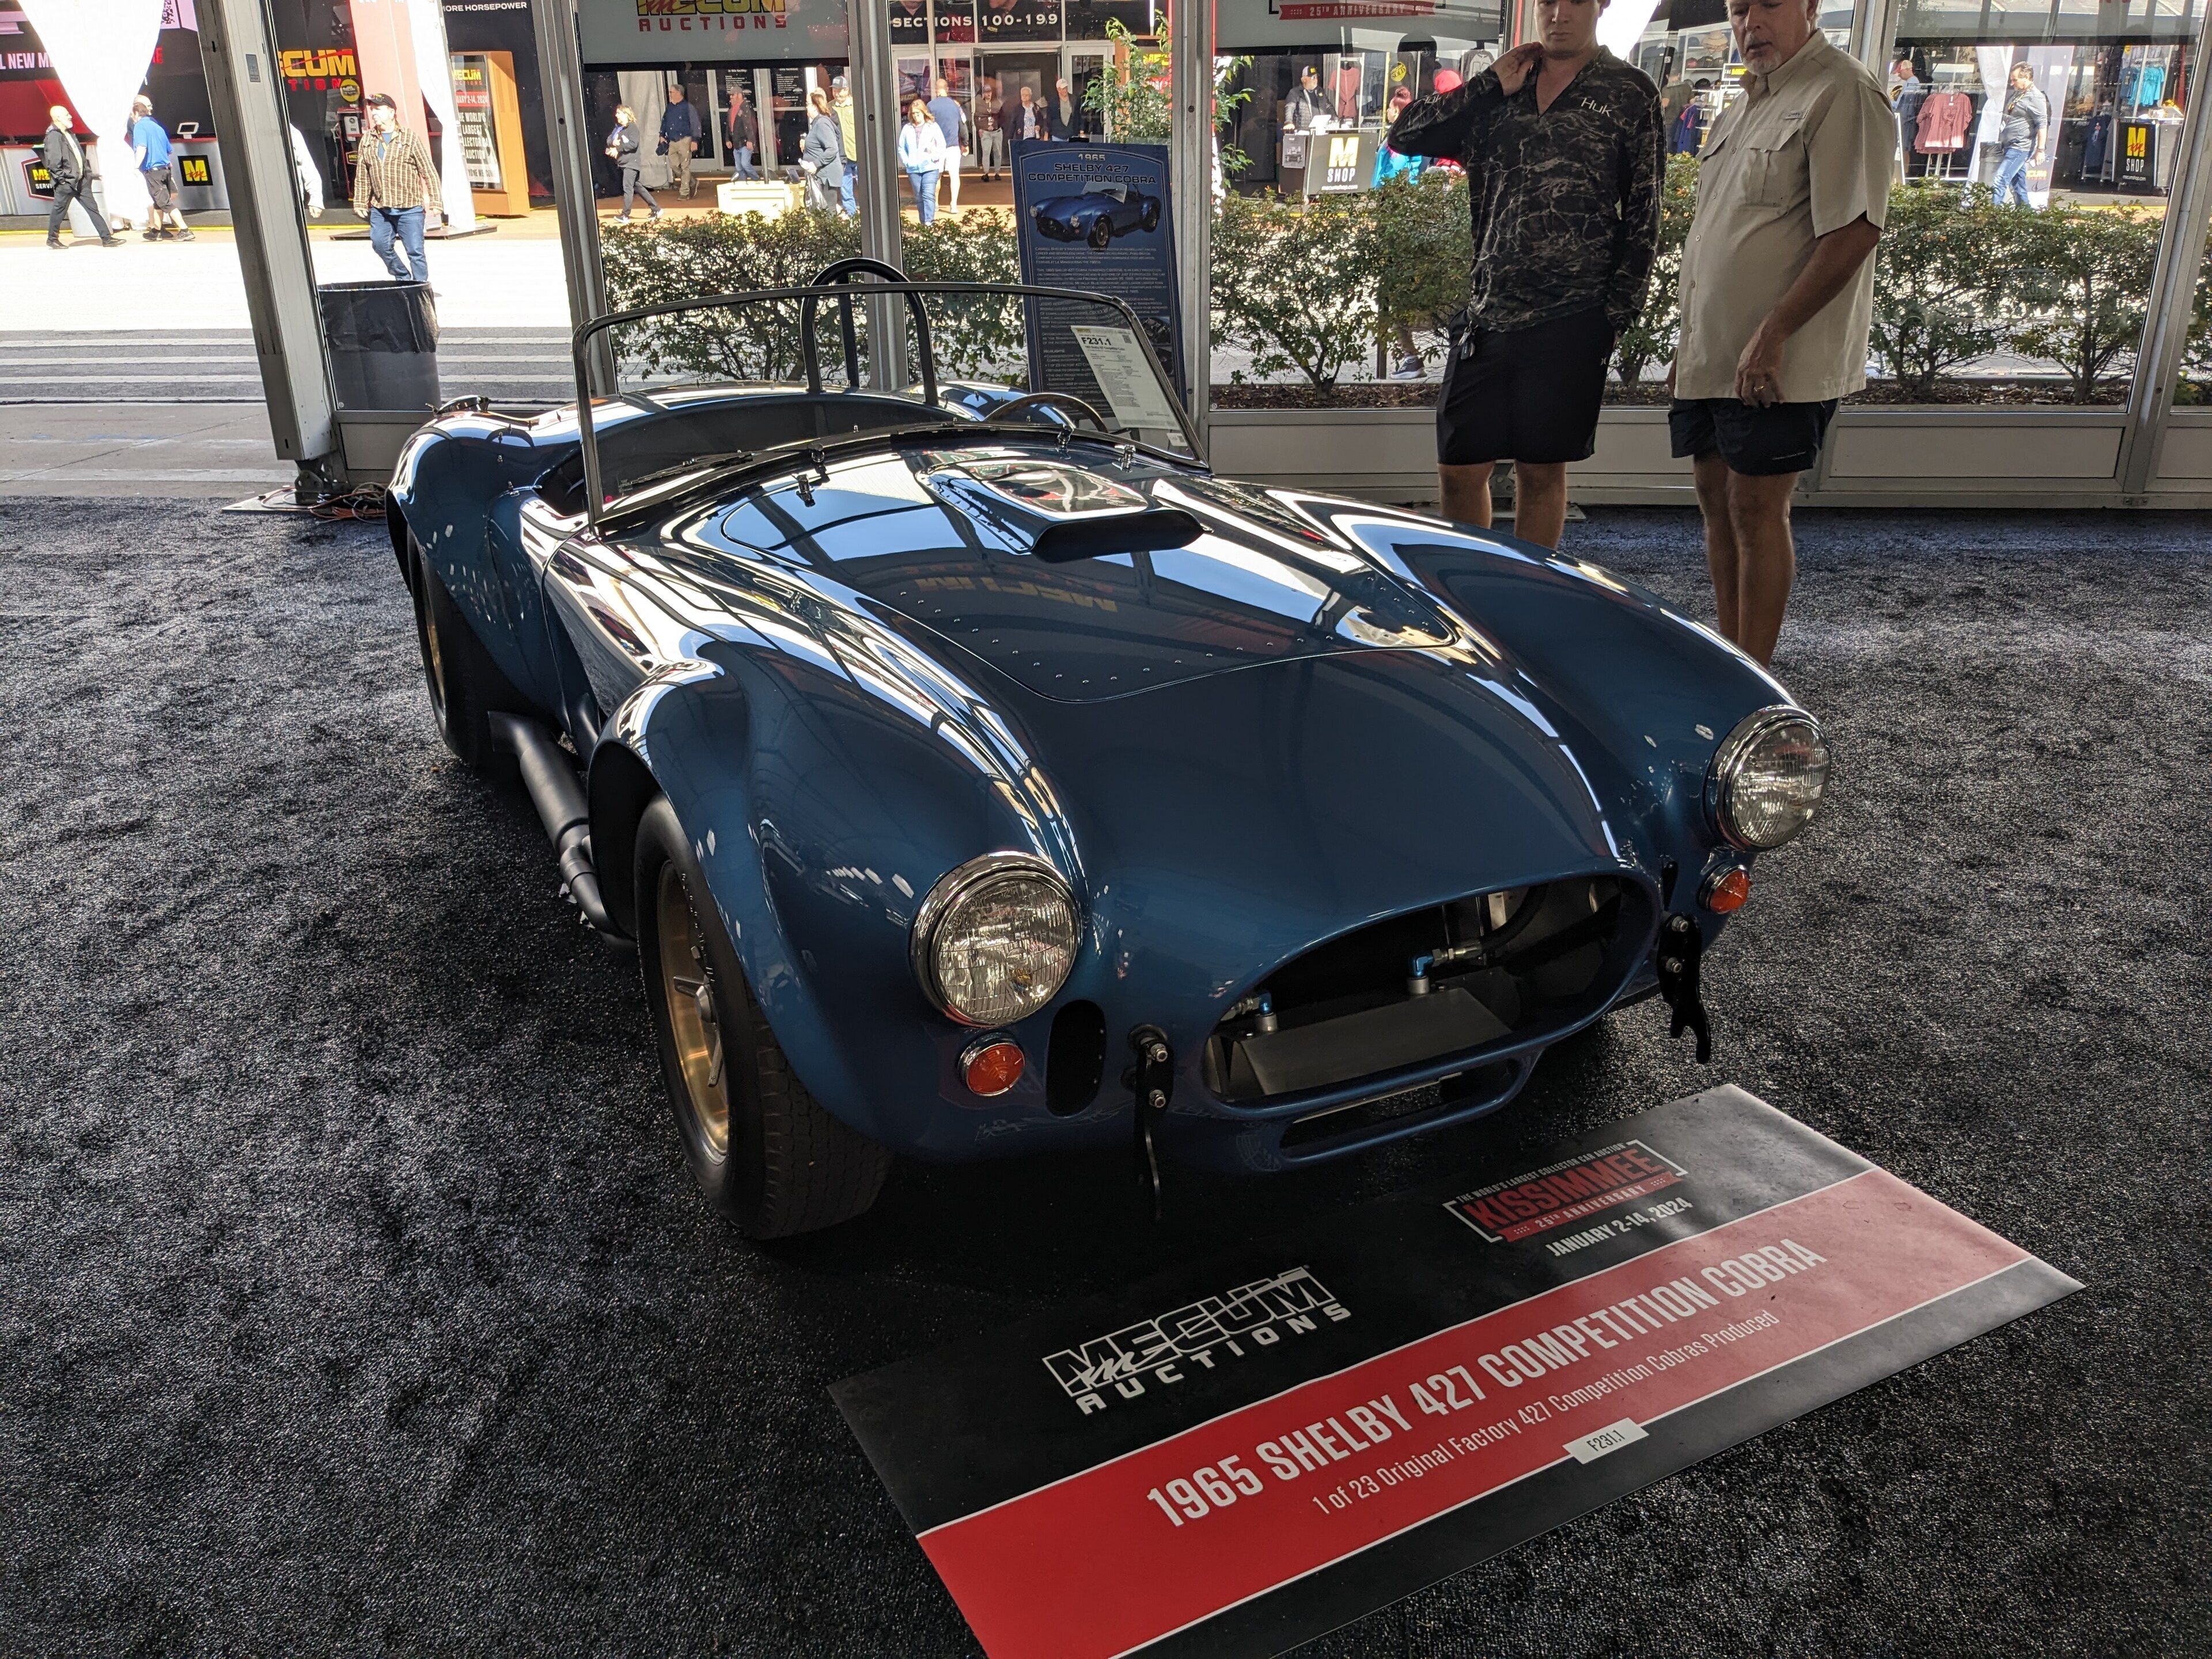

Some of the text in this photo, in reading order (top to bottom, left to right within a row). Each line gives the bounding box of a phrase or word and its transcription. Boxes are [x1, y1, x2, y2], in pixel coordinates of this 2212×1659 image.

[465, 2, 527, 12] HORSEPOWER
[1333, 4, 1405, 16] ANNIVERSARY
[639, 15, 787, 32] AUCTIONS
[982, 13, 1058, 26] 100-199
[9, 52, 35, 69] NEW
[462, 124, 483, 135] LARGEST
[465, 149, 486, 160] AUCTION
[1055, 163, 1129, 173] SHELBY 427
[2126, 158, 2144, 172] SHOP
[1028, 173, 1157, 184] COMPETITION COBRA
[1327, 168, 1355, 183] SHOP
[1081, 336, 1112, 346] F231.1
[1456, 1143, 1626, 1203] THE WORLD'S LARGEST COLLECTOR CAR AUCTION
[1461, 1148, 1666, 1230] KISSIMMEE
[1563, 1185, 1647, 1219] ANNIVERSARY
[1546, 1197, 1694, 1257] JANUARY 2-14, 2024
[1042, 1266, 1336, 1397] MECUM
[1076, 1302, 1351, 1415] AUCTIONS
[1147, 1238, 1828, 1527] 1965 SHELBY 427 COMPETITION COBRA
[1312, 1309, 1781, 1514] 1 of 23 Original Factory 427 Competition Cobras Produced
[1585, 1429, 1626, 1452] F231.1
